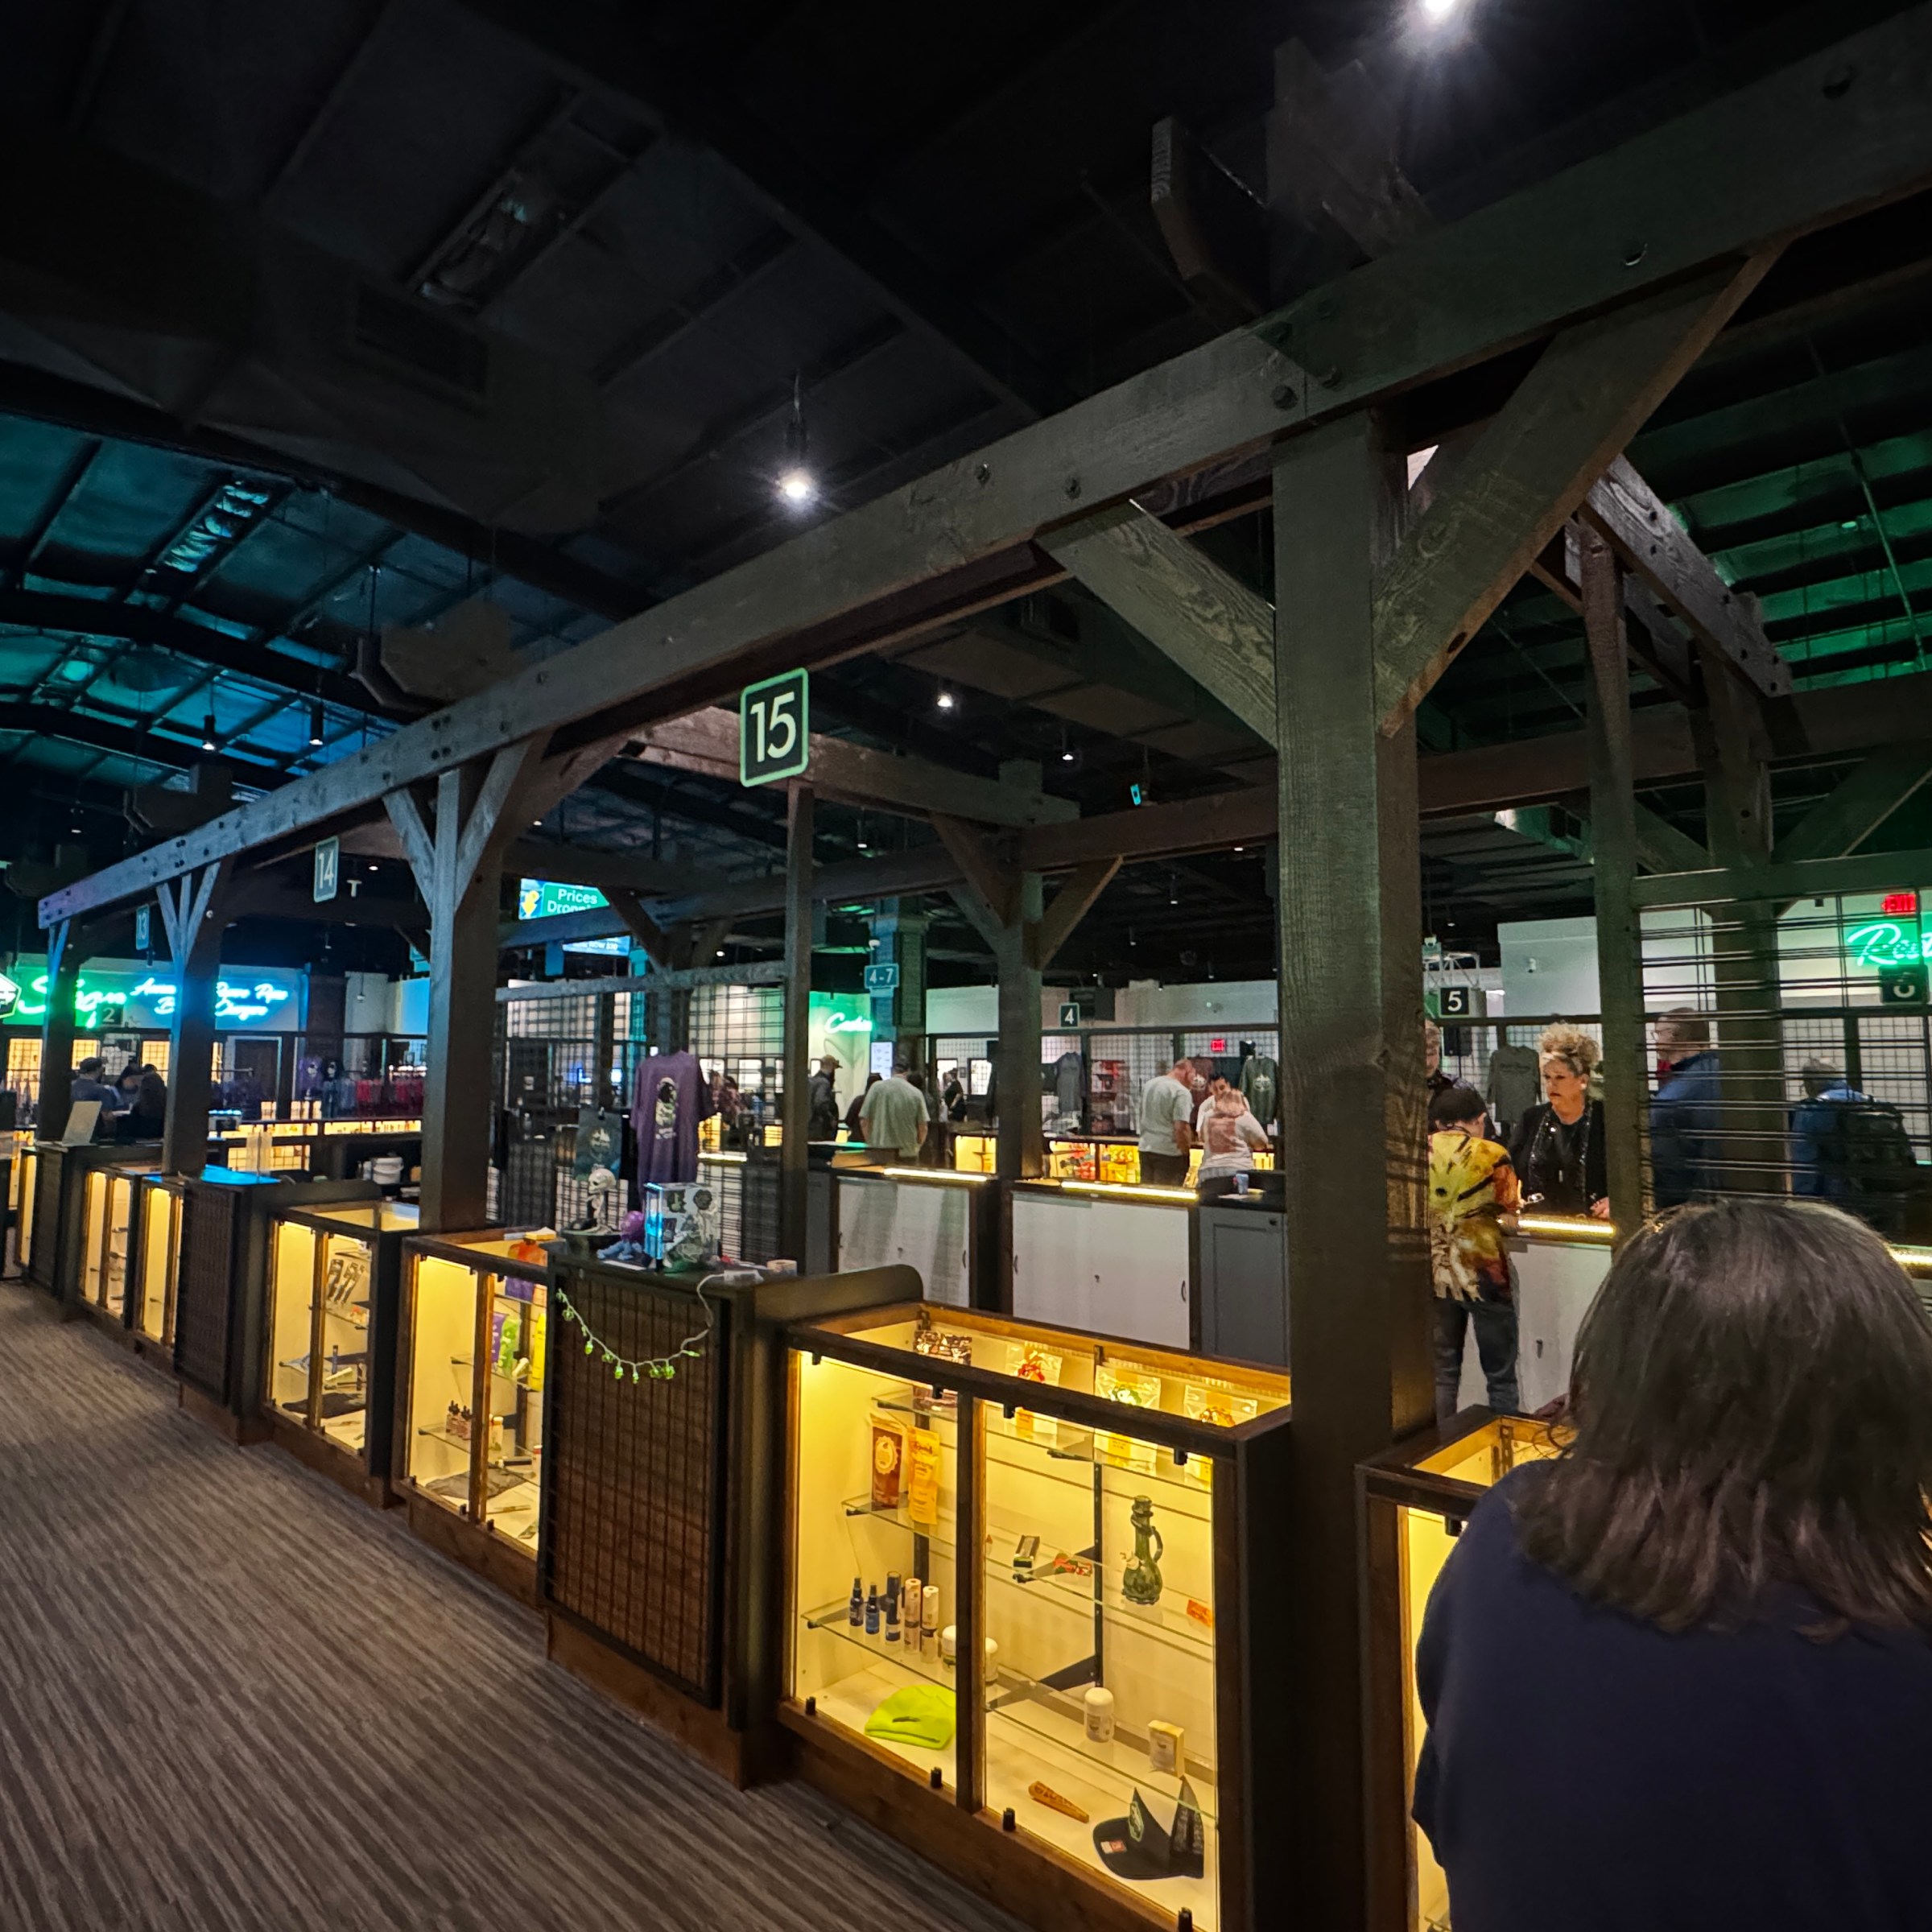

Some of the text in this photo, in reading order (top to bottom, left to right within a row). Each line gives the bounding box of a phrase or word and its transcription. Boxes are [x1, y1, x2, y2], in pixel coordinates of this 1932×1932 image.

[749, 691, 797, 763] 15
[318, 850, 334, 890] 14
[557, 888, 598, 905] Prices
[869, 968, 894, 984] 4-7
[1447, 990, 1463, 1012] 5
[102, 1006, 115, 1022] 2
[1064, 1008, 1075, 1025] 4
